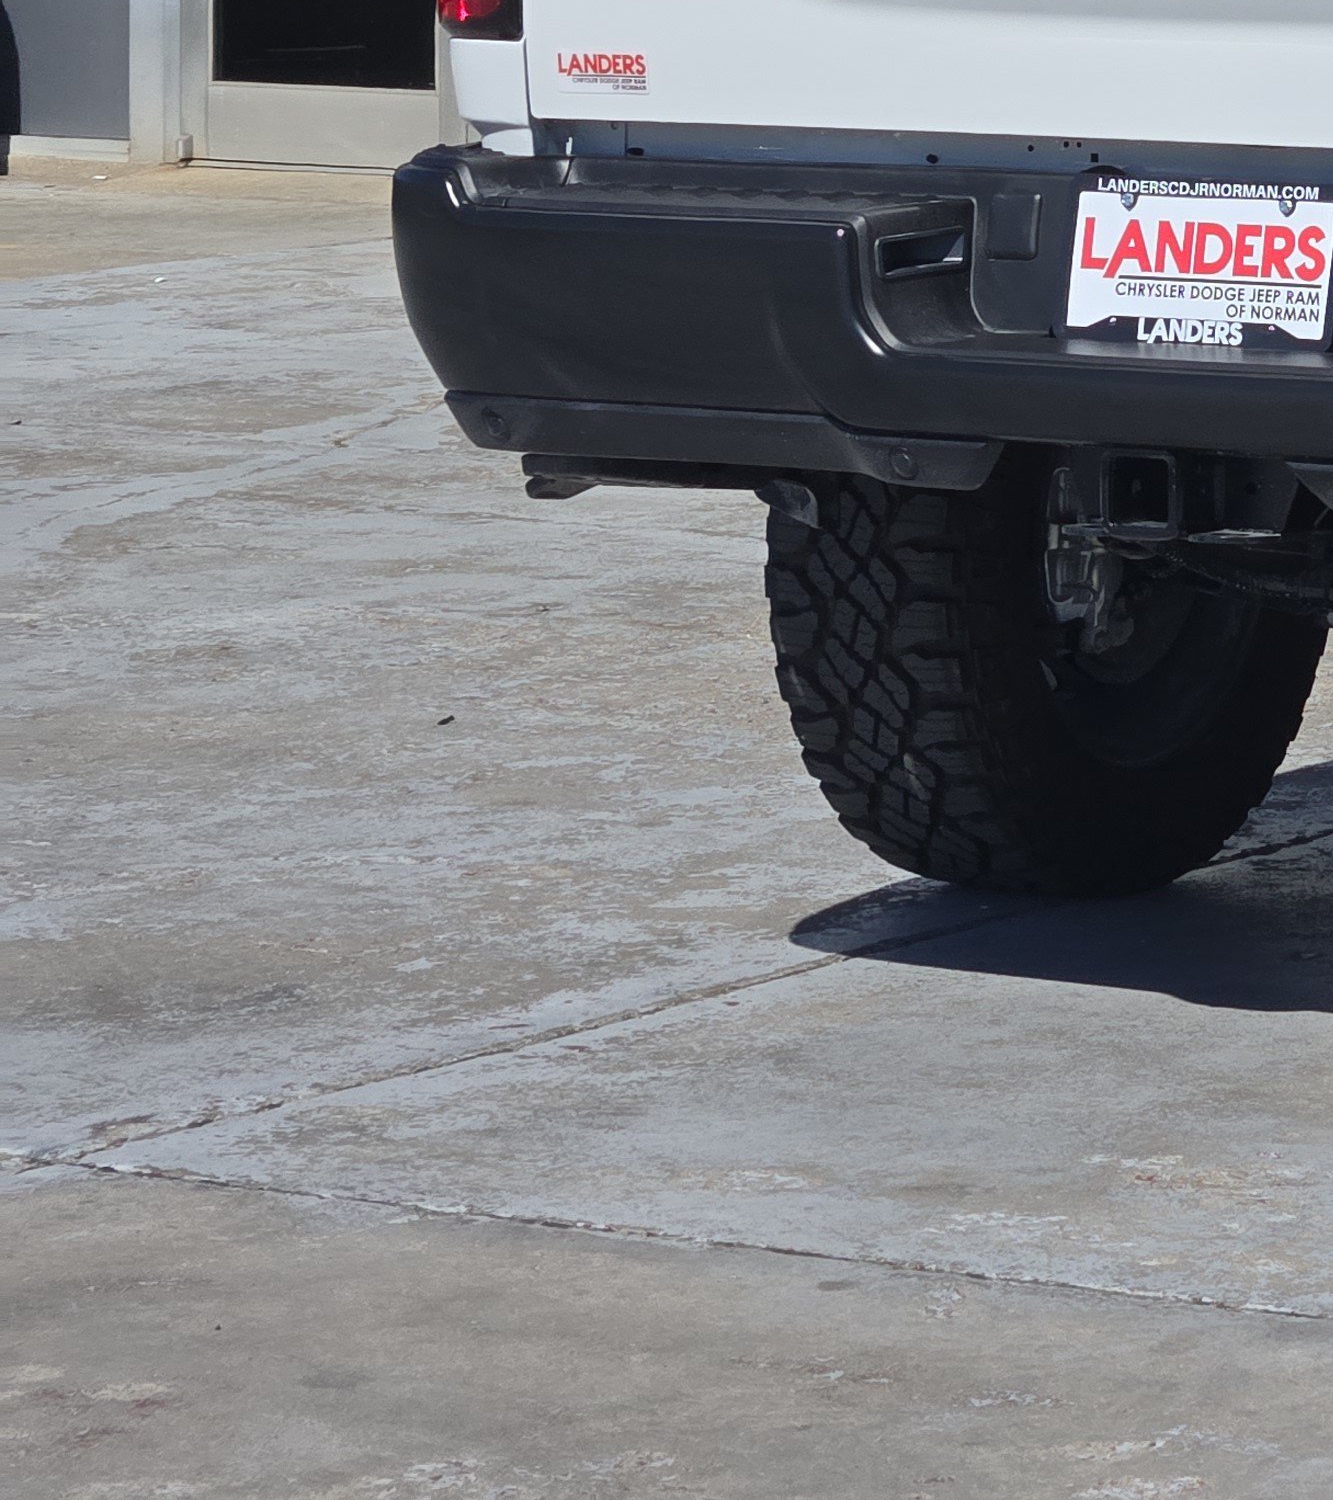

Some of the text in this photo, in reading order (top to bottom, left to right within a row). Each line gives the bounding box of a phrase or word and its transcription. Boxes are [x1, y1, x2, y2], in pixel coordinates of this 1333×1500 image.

[557, 53, 646, 76] LANDERS
[1097, 177, 1320, 200] LANDERSCDJRNORMAN.COM
[1080, 216, 1326, 282] LANDERS
[1115, 282, 1320, 306] CHRYSLER DODGE JEEP RAM
[1226, 303, 1320, 322] OF NORMAN
[1137, 317, 1243, 346] LANDERS
